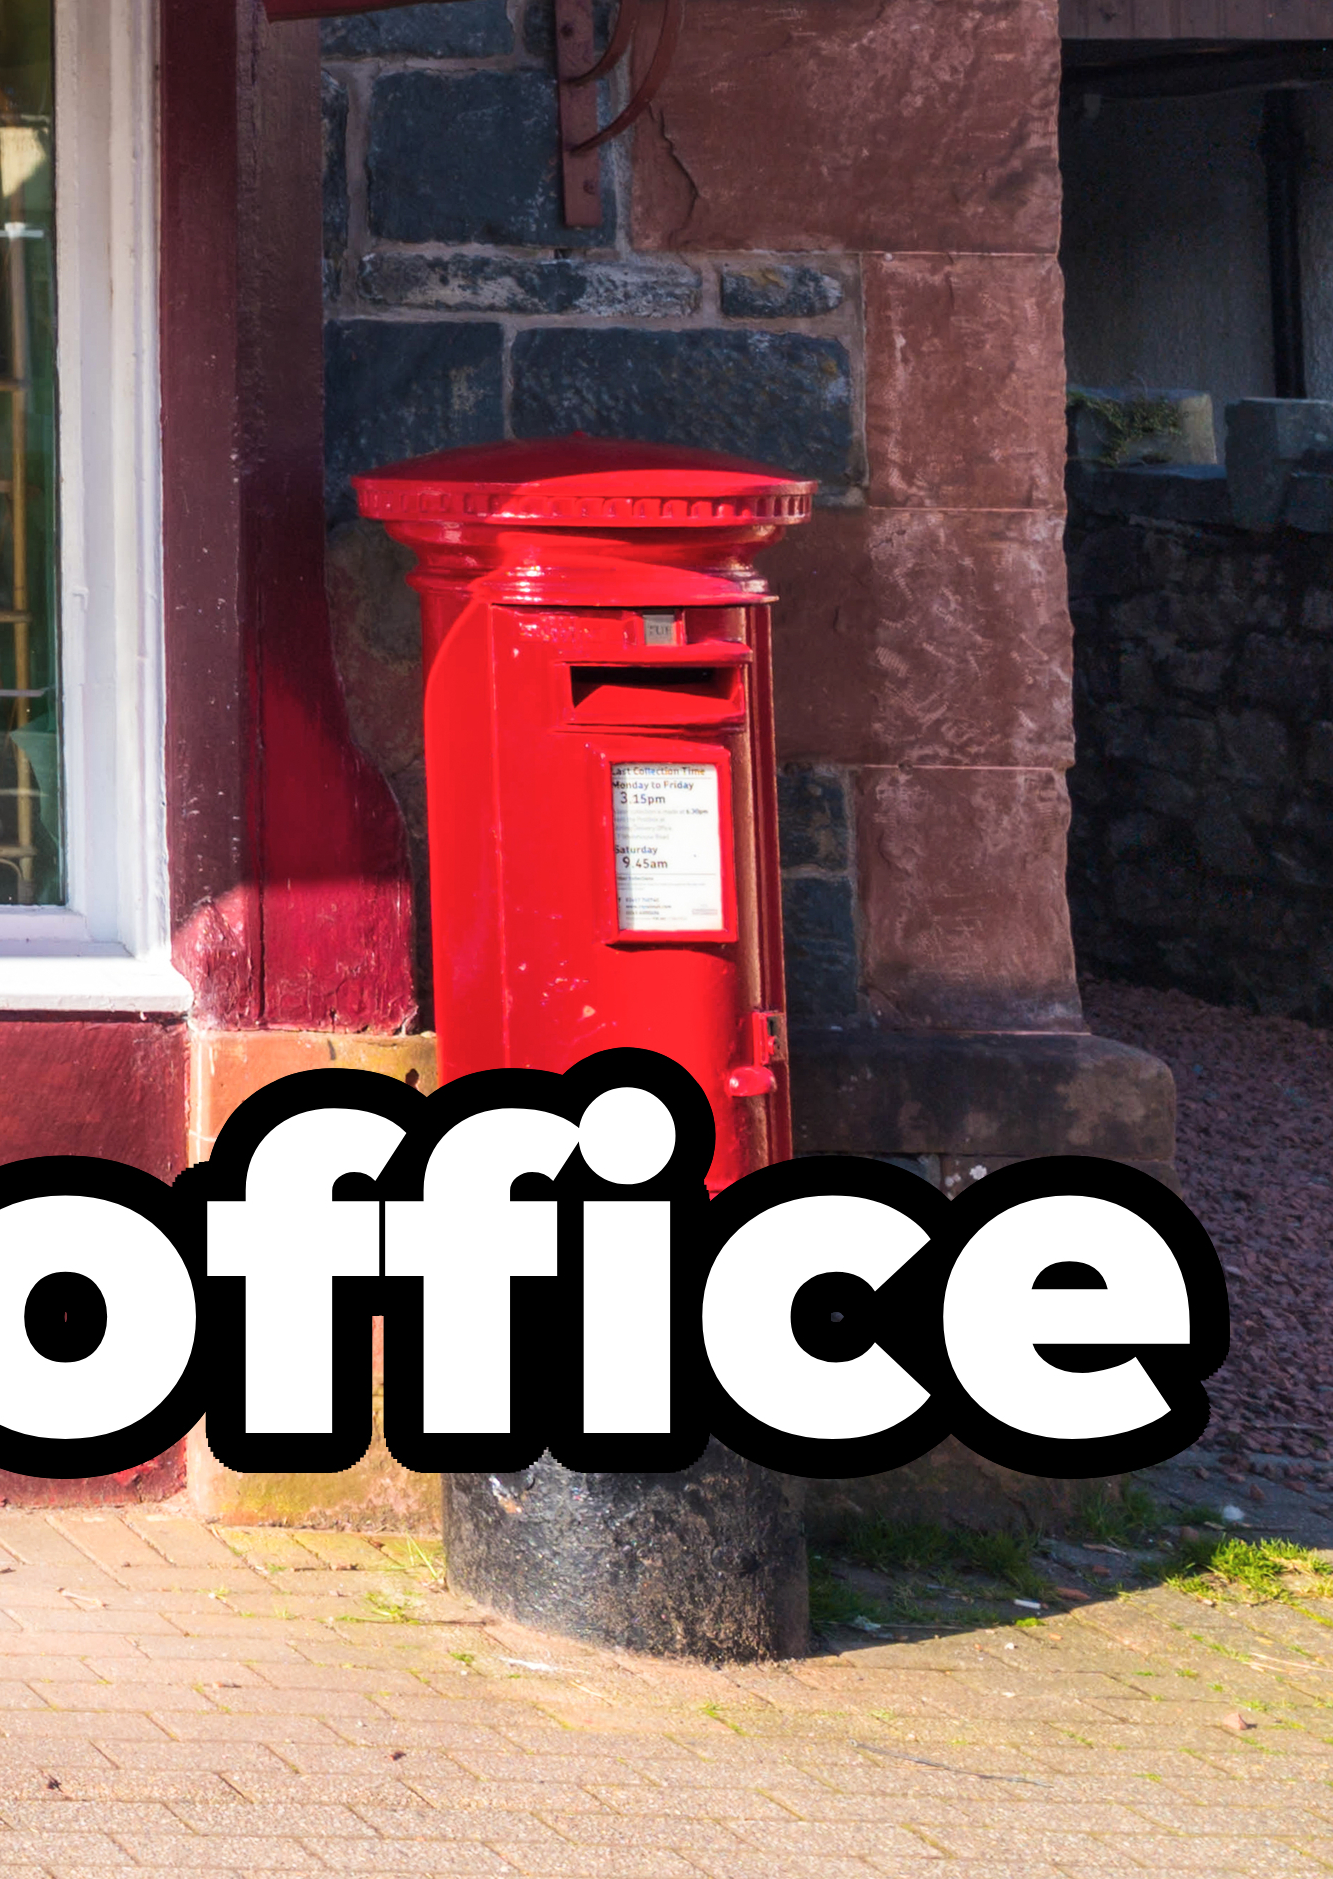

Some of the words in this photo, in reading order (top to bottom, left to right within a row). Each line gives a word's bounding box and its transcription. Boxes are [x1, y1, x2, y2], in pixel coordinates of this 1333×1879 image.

[612, 767, 630, 776] Last
[633, 766, 680, 776] Collection
[682, 766, 705, 776] Time
[612, 781, 649, 791] Monday
[651, 781, 661, 789] to
[663, 780, 694, 791] Friday
[620, 791, 666, 806] 3.15pm
[614, 844, 659, 855] Saturday
[622, 856, 669, 869] 9.45am
